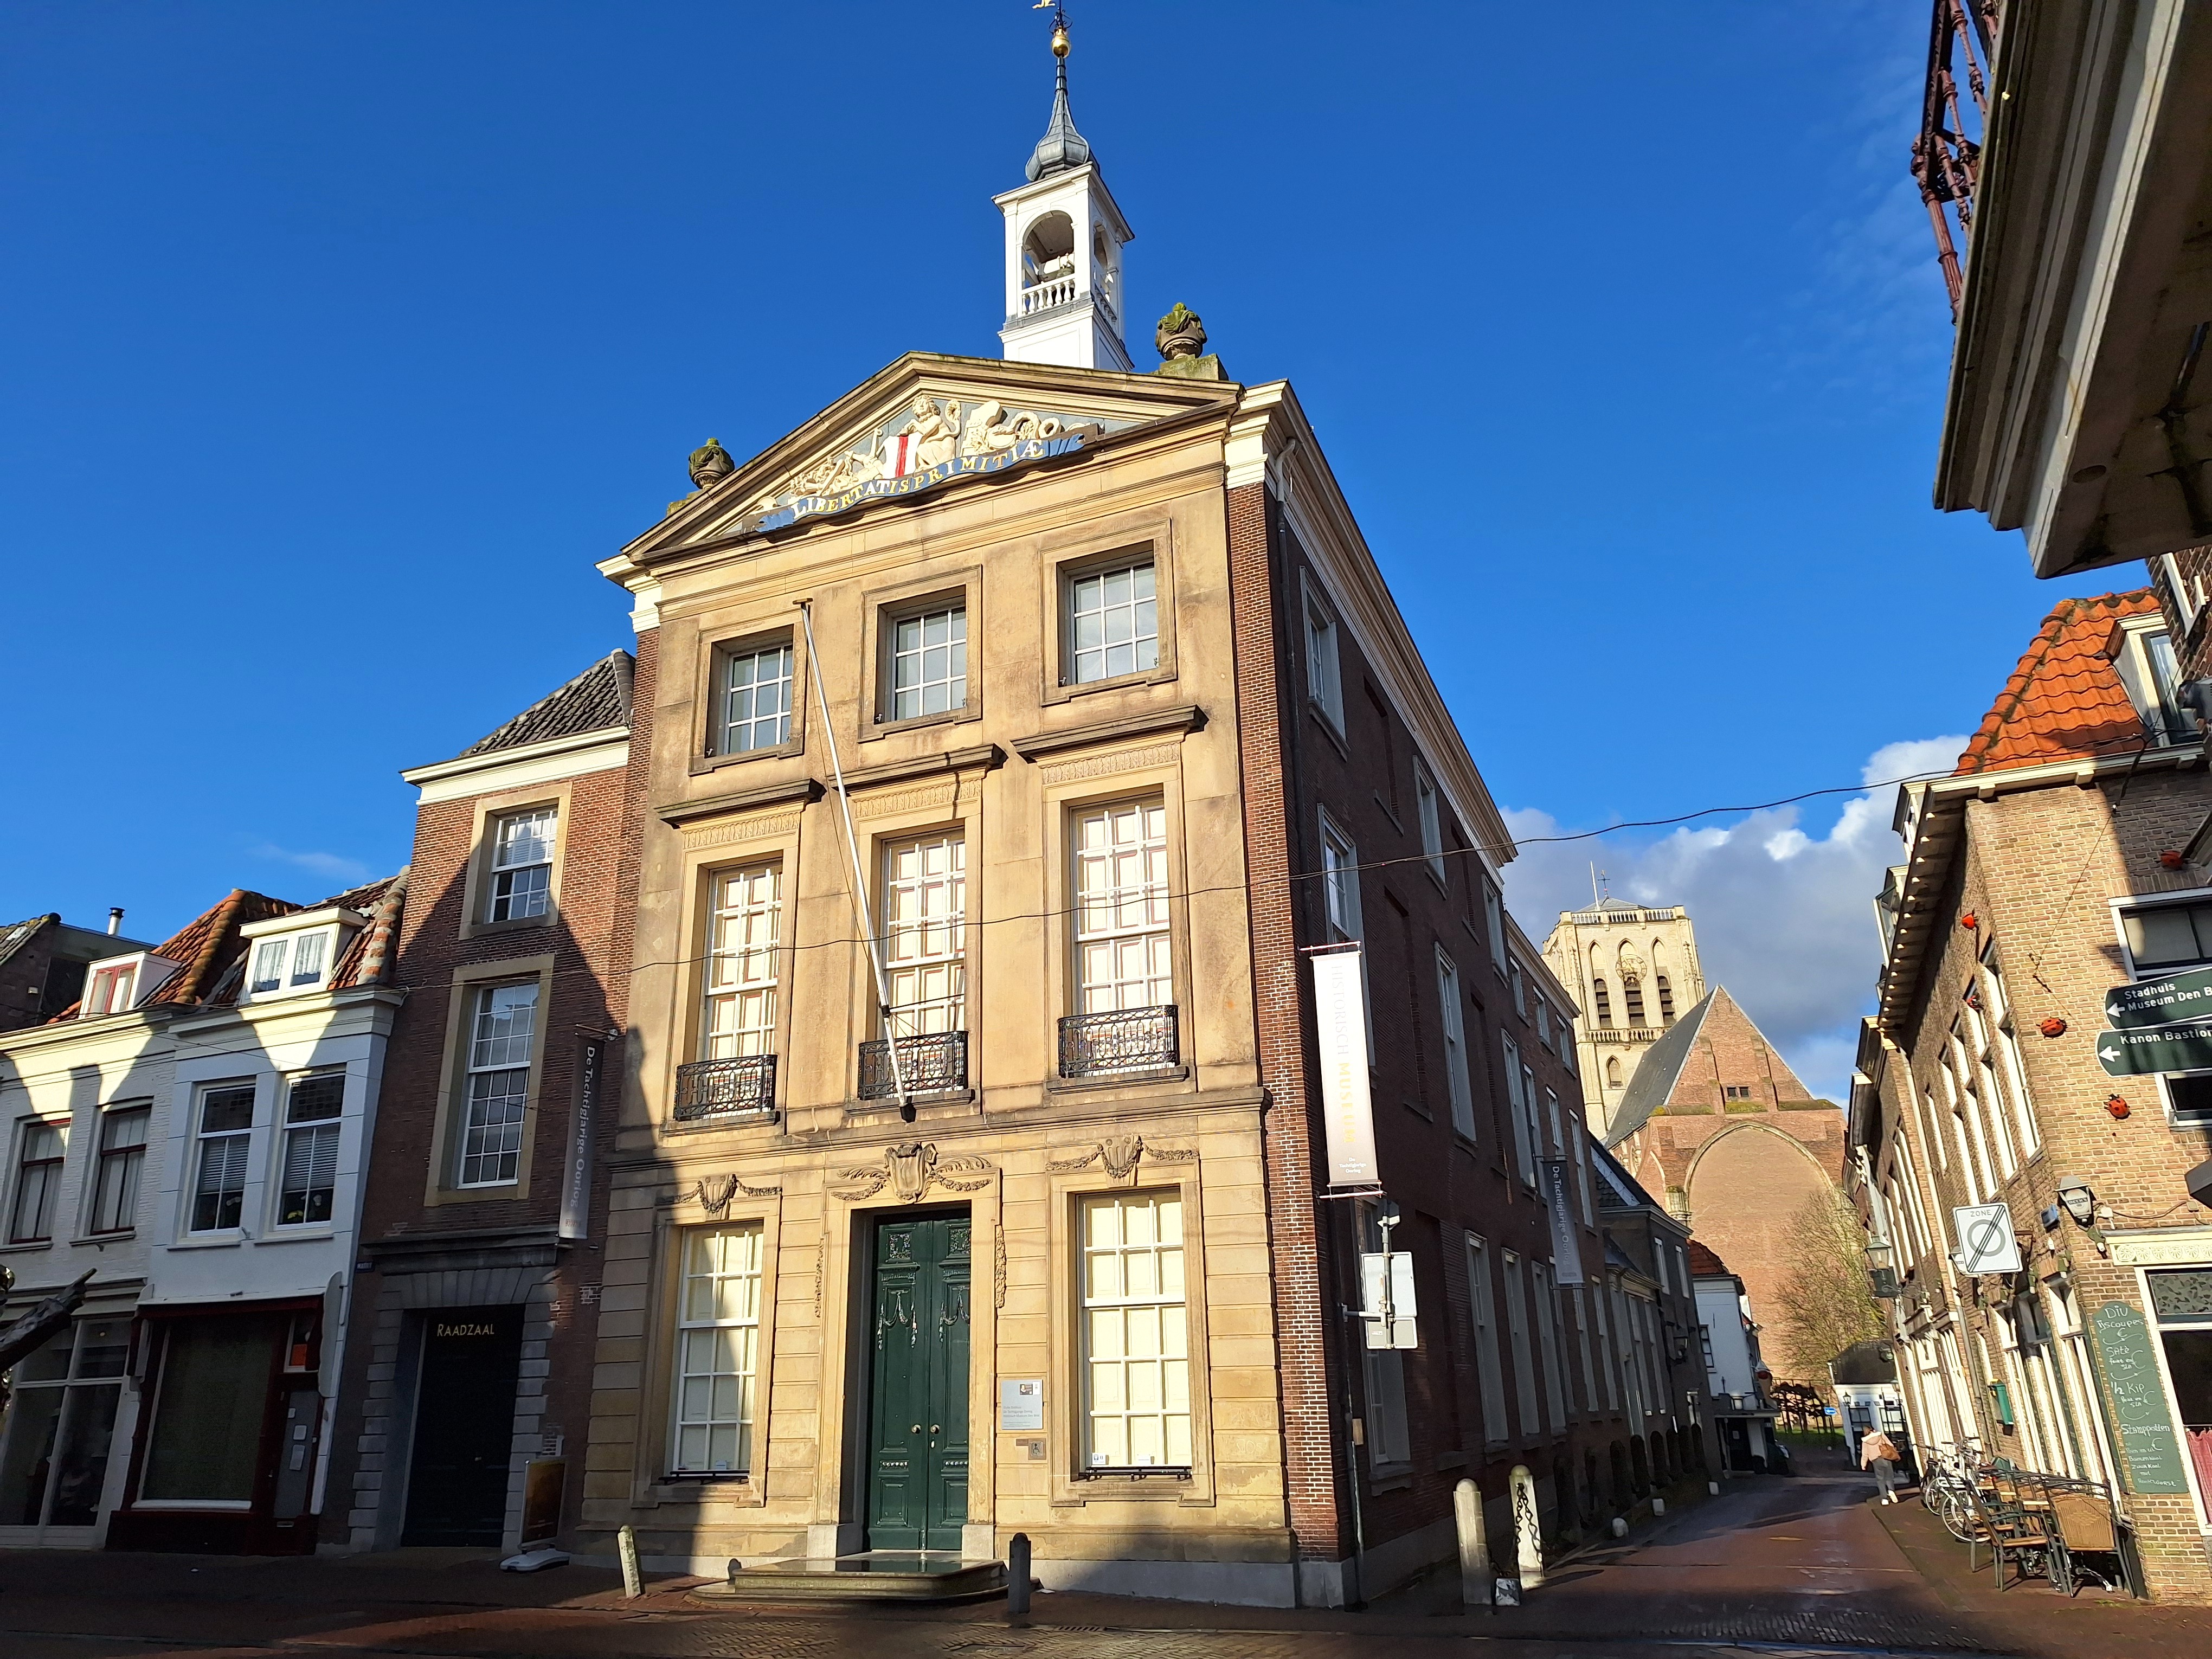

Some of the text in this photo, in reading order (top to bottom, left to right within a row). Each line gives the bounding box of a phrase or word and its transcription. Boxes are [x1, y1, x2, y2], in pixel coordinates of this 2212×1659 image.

[792, 477, 909, 519] LIBERTATIS
[2124, 982, 2176, 1000] Stadhuis
[2127, 995, 2175, 1012] Museum
[2177, 990, 2201, 1001] Den
[2119, 1034, 2161, 1045] Kanon
[586, 1046, 595, 1066] De
[1331, 965, 1355, 1143] HISTORISCH MUSEUM
[577, 1068, 593, 1154] Tachtigjarige
[570, 1159, 585, 1208] Oorlog
[1552, 1166, 1559, 1179] De
[1561, 1235, 1571, 1266] Oorlog
[1970, 1209, 1992, 1217] ZONE
[437, 1323, 495, 1336] RAADZAAL
